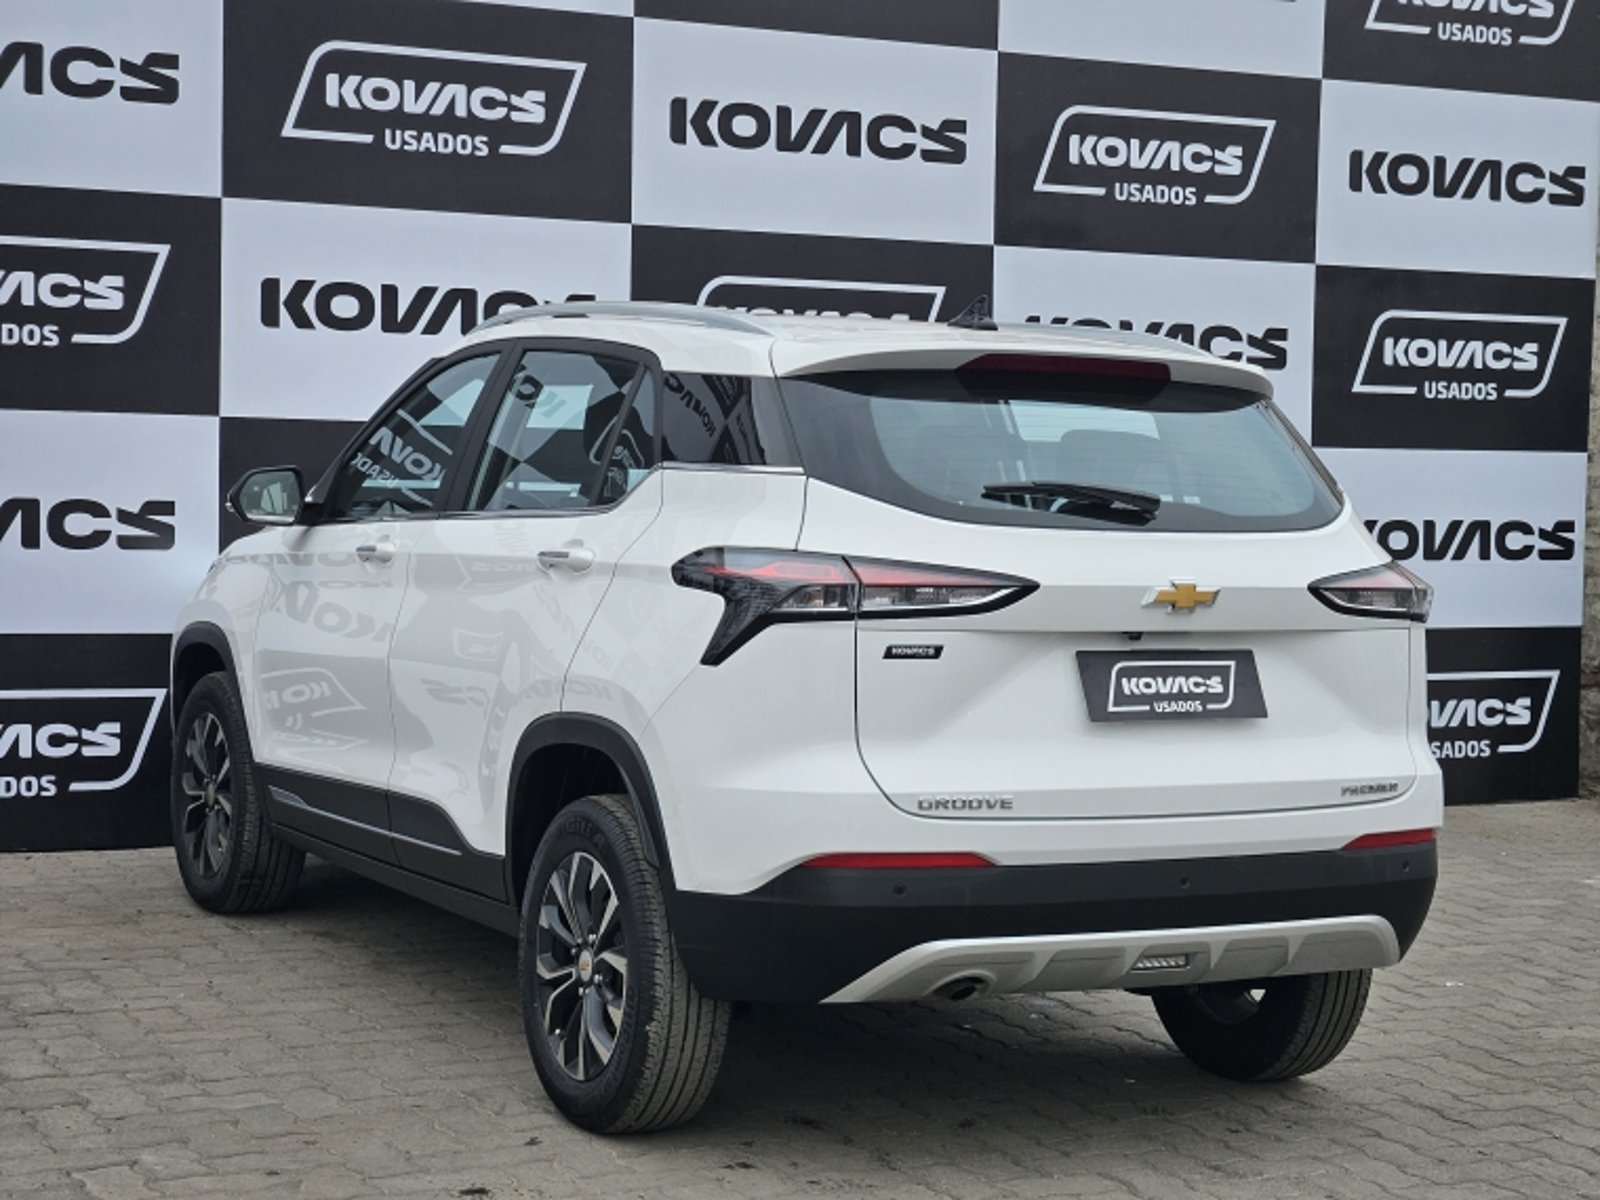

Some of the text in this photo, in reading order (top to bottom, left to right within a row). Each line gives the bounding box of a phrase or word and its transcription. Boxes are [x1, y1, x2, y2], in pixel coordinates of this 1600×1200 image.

[1437, 22, 1513, 46] USADOS
[325, 73, 546, 123] KOVACS
[384, 130, 490, 156] USADOS
[669, 96, 967, 165] KOVACS
[1069, 134, 1243, 176] KOVACS
[1348, 149, 1586, 207] KOVACS
[1114, 182, 1197, 206] USADOS
[0, 270, 125, 310] ACS
[1, 323, 60, 346] DOS
[1383, 337, 1539, 371] KOVACS
[1423, 380, 1498, 401] USADOS
[1121, 675, 1224, 696] KOVACS
[1153, 700, 1203, 712] USADOS
[0, 721, 121, 758] ACS
[917, 795, 1014, 811] GROOVE
